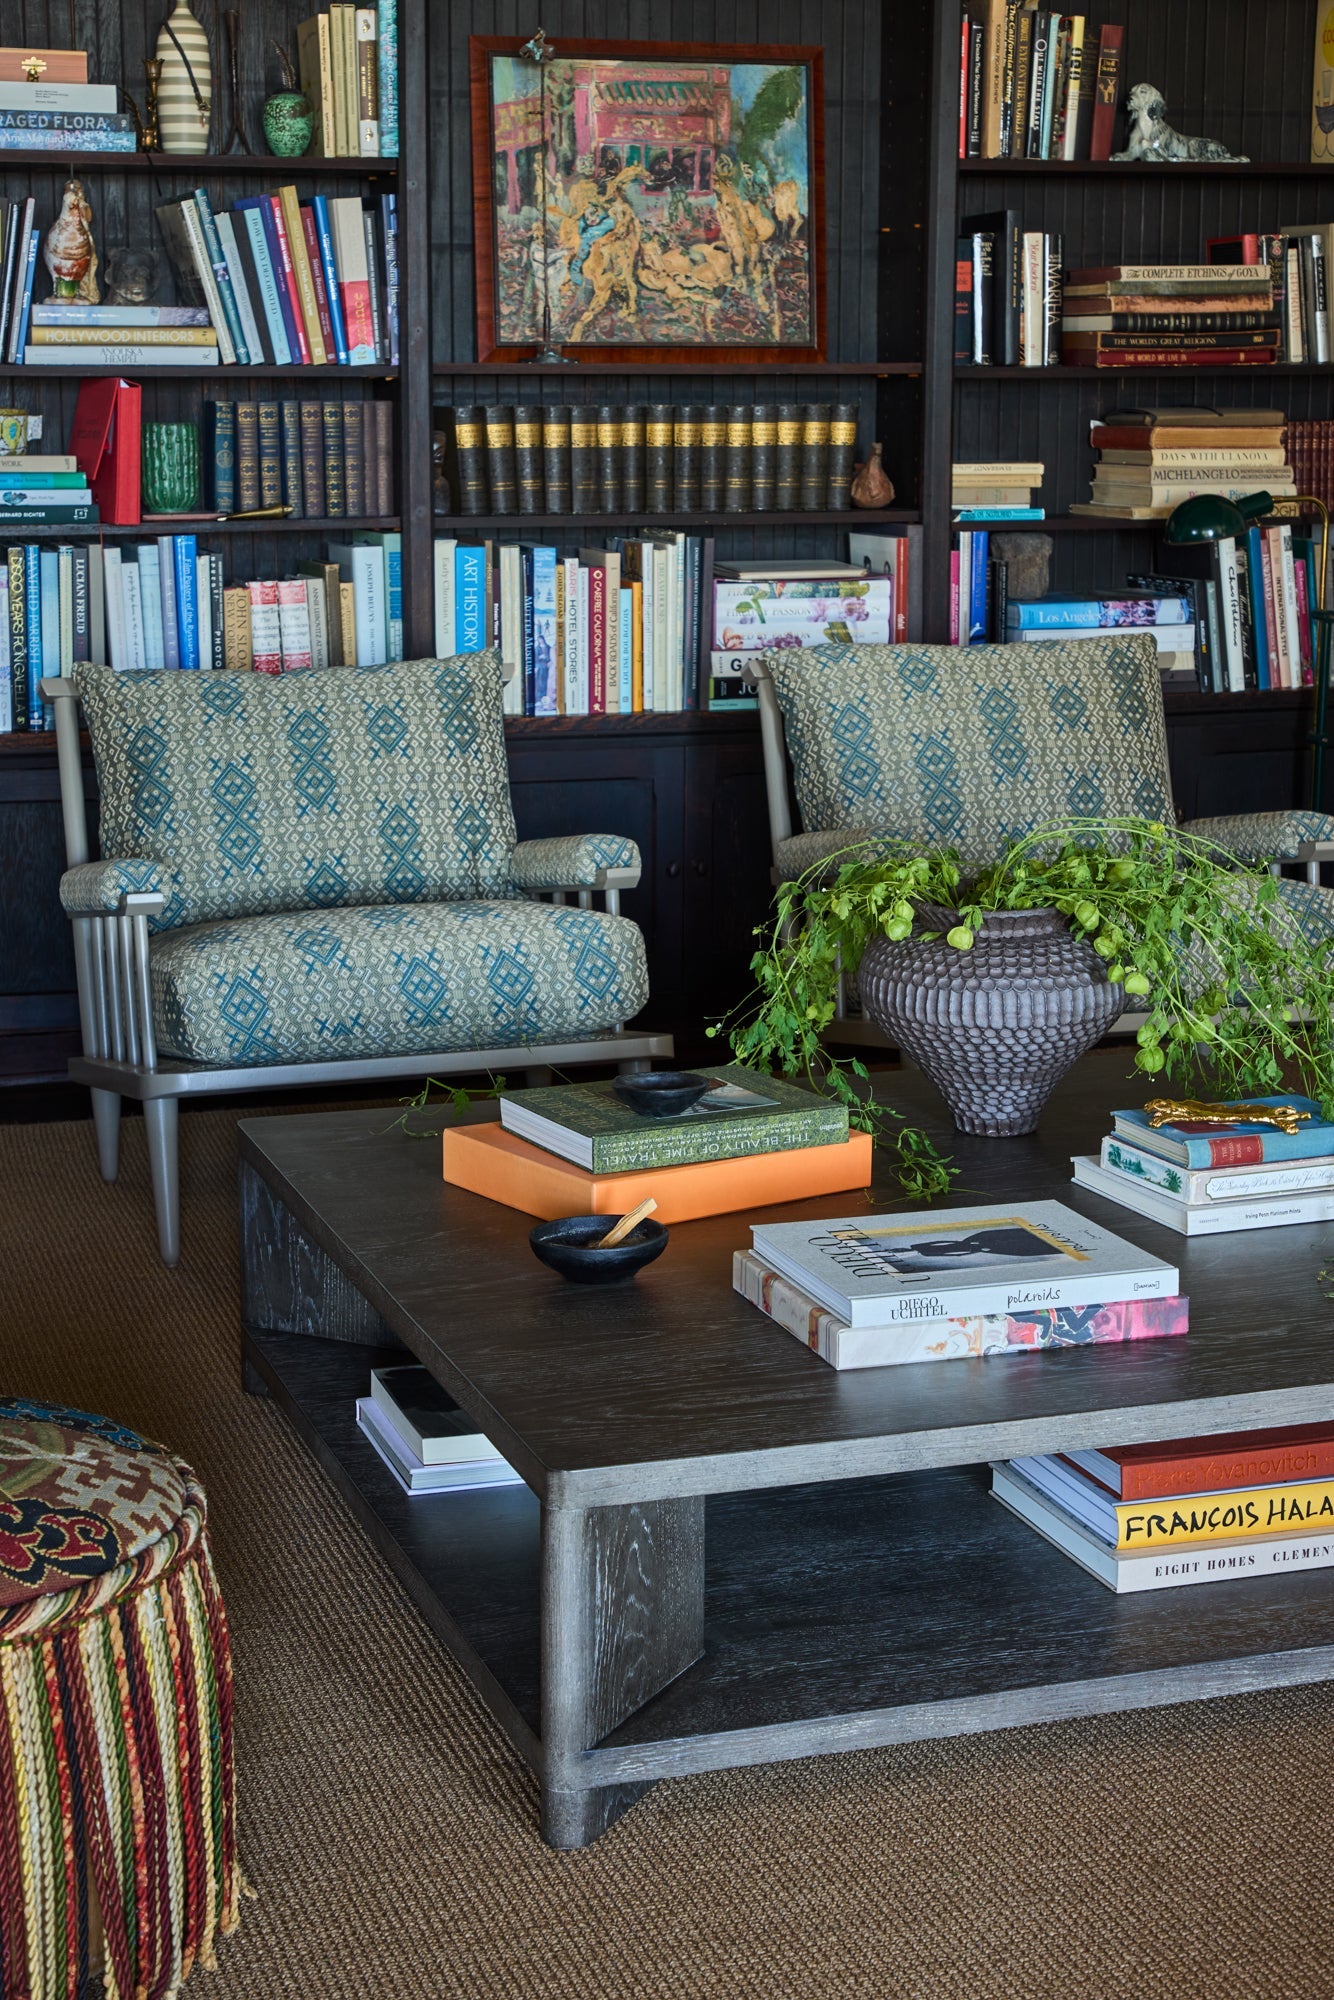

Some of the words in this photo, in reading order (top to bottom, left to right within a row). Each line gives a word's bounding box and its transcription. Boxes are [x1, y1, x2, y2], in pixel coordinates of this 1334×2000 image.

[1008, 3, 1017, 23] The
[386, 25, 394, 59] WILLIAMS
[1005, 23, 1016, 67] California
[1018, 44, 1028, 63] EYE
[972, 73, 980, 91] Shaped
[1017, 63, 1027, 79] ON
[387, 74, 395, 103] GARDEN
[1003, 69, 1014, 103] Feeling
[1016, 79, 1026, 99] THE
[972, 91, 980, 114] Television
[54, 116, 106, 129] FLORA
[387, 105, 395, 127] STYLE
[1013, 100, 1025, 135] WORLD
[197, 194, 213, 223] English
[250, 216, 263, 238] HOW
[254, 237, 268, 262] THEY
[384, 228, 396, 261] Bringing
[311, 257, 321, 277] Silent
[387, 260, 398, 284] Nature
[1126, 269, 1141, 279] The
[1142, 268, 1185, 279] COMPLETE
[1187, 267, 1227, 278] ETCHINGS
[1227, 267, 1236, 282] of
[1236, 268, 1259, 278] GOYA
[259, 262, 280, 316] DECORATED
[314, 276, 326, 305] Beauties
[389, 285, 399, 306] Home
[1043, 263, 1061, 327] MARTHA
[46, 330, 131, 342] HOLLYWOOD
[134, 330, 195, 342] INTERIORS
[1129, 337, 1158, 345] WORLD'S
[1160, 337, 1181, 345] GREAT
[1184, 337, 1217, 345] RELIGIONS
[1125, 354, 1135, 362] THE
[1136, 354, 1156, 362] WORLD
[1158, 354, 1166, 362] WE
[1161, 452, 1186, 461] DAYS
[1190, 452, 1218, 461] WITH
[1221, 451, 1269, 461] ULANOVA
[1153, 468, 1240, 481] MICHELANGELO
[9, 556, 24, 592] DISCO
[74, 558, 86, 597] LUCIAN
[183, 557, 193, 576] Film
[364, 562, 375, 593] JOSEPH
[438, 556, 450, 579] Early
[463, 555, 478, 584] ART
[567, 562, 577, 596] PARIS
[25, 551, 40, 611] MAXFIELD
[183, 575, 194, 602] Posters
[185, 602, 194, 611] of
[225, 592, 236, 618] NEW
[311, 585, 320, 606] ANNIE
[440, 579, 452, 618] Christian
[592, 579, 603, 614] CAREFREE
[607, 587, 618, 623] California
[1275, 575, 1286, 634] INTERNATIONAL
[10, 594, 24, 633] YEARS
[75, 598, 86, 633] FREUD
[164, 578, 177, 658] MAGRITTE
[185, 610, 195, 623] the
[234, 592, 248, 630] JOHN
[312, 606, 322, 638] LEIBOVITZ
[366, 595, 376, 624] BEUYS
[463, 587, 478, 649] HISTORY
[567, 598, 578, 636] HOTEL
[772, 608, 812, 617] PASSION
[1039, 611, 1060, 624] Los
[1060, 610, 1102, 625] Angeles
[27, 613, 41, 663] PARRISH
[185, 623, 197, 651] Russian
[226, 622, 237, 652] YORK
[442, 619, 453, 635] Art
[593, 613, 603, 658] CALIFORNIA
[608, 622, 617, 632] of
[11, 634, 26, 663] RON
[213, 630, 222, 668] PHOTO
[315, 638, 322, 648] AT
[523, 635, 535, 675] MUSEUM
[608, 631, 617, 660] ROADS
[1279, 634, 1288, 657] STYLE
[567, 638, 578, 684] STORIES
[12, 662, 26, 713] GALELLA
[608, 662, 617, 687] BACK
[700, 1142, 720, 1154] OF
[722, 1135, 778, 1151] BEAUTY
[782, 1132, 810, 1144] THE
[602, 1151, 658, 1166] TRAVEL
[665, 1146, 694, 1159] TIME
[898, 1296, 939, 1310] DIEGO
[1007, 1287, 1061, 1309] polaroids
[890, 1305, 948, 1321] UCHITEL
[1135, 1464, 1197, 1489] Pierre
[1199, 1450, 1318, 1480] Yovanovitch
[1125, 1501, 1259, 1542] FRANÇOIS
[1266, 1495, 1334, 1526] HALA
[1154, 1561, 1201, 1577] EIGHT
[1207, 1554, 1256, 1571] HOMES
